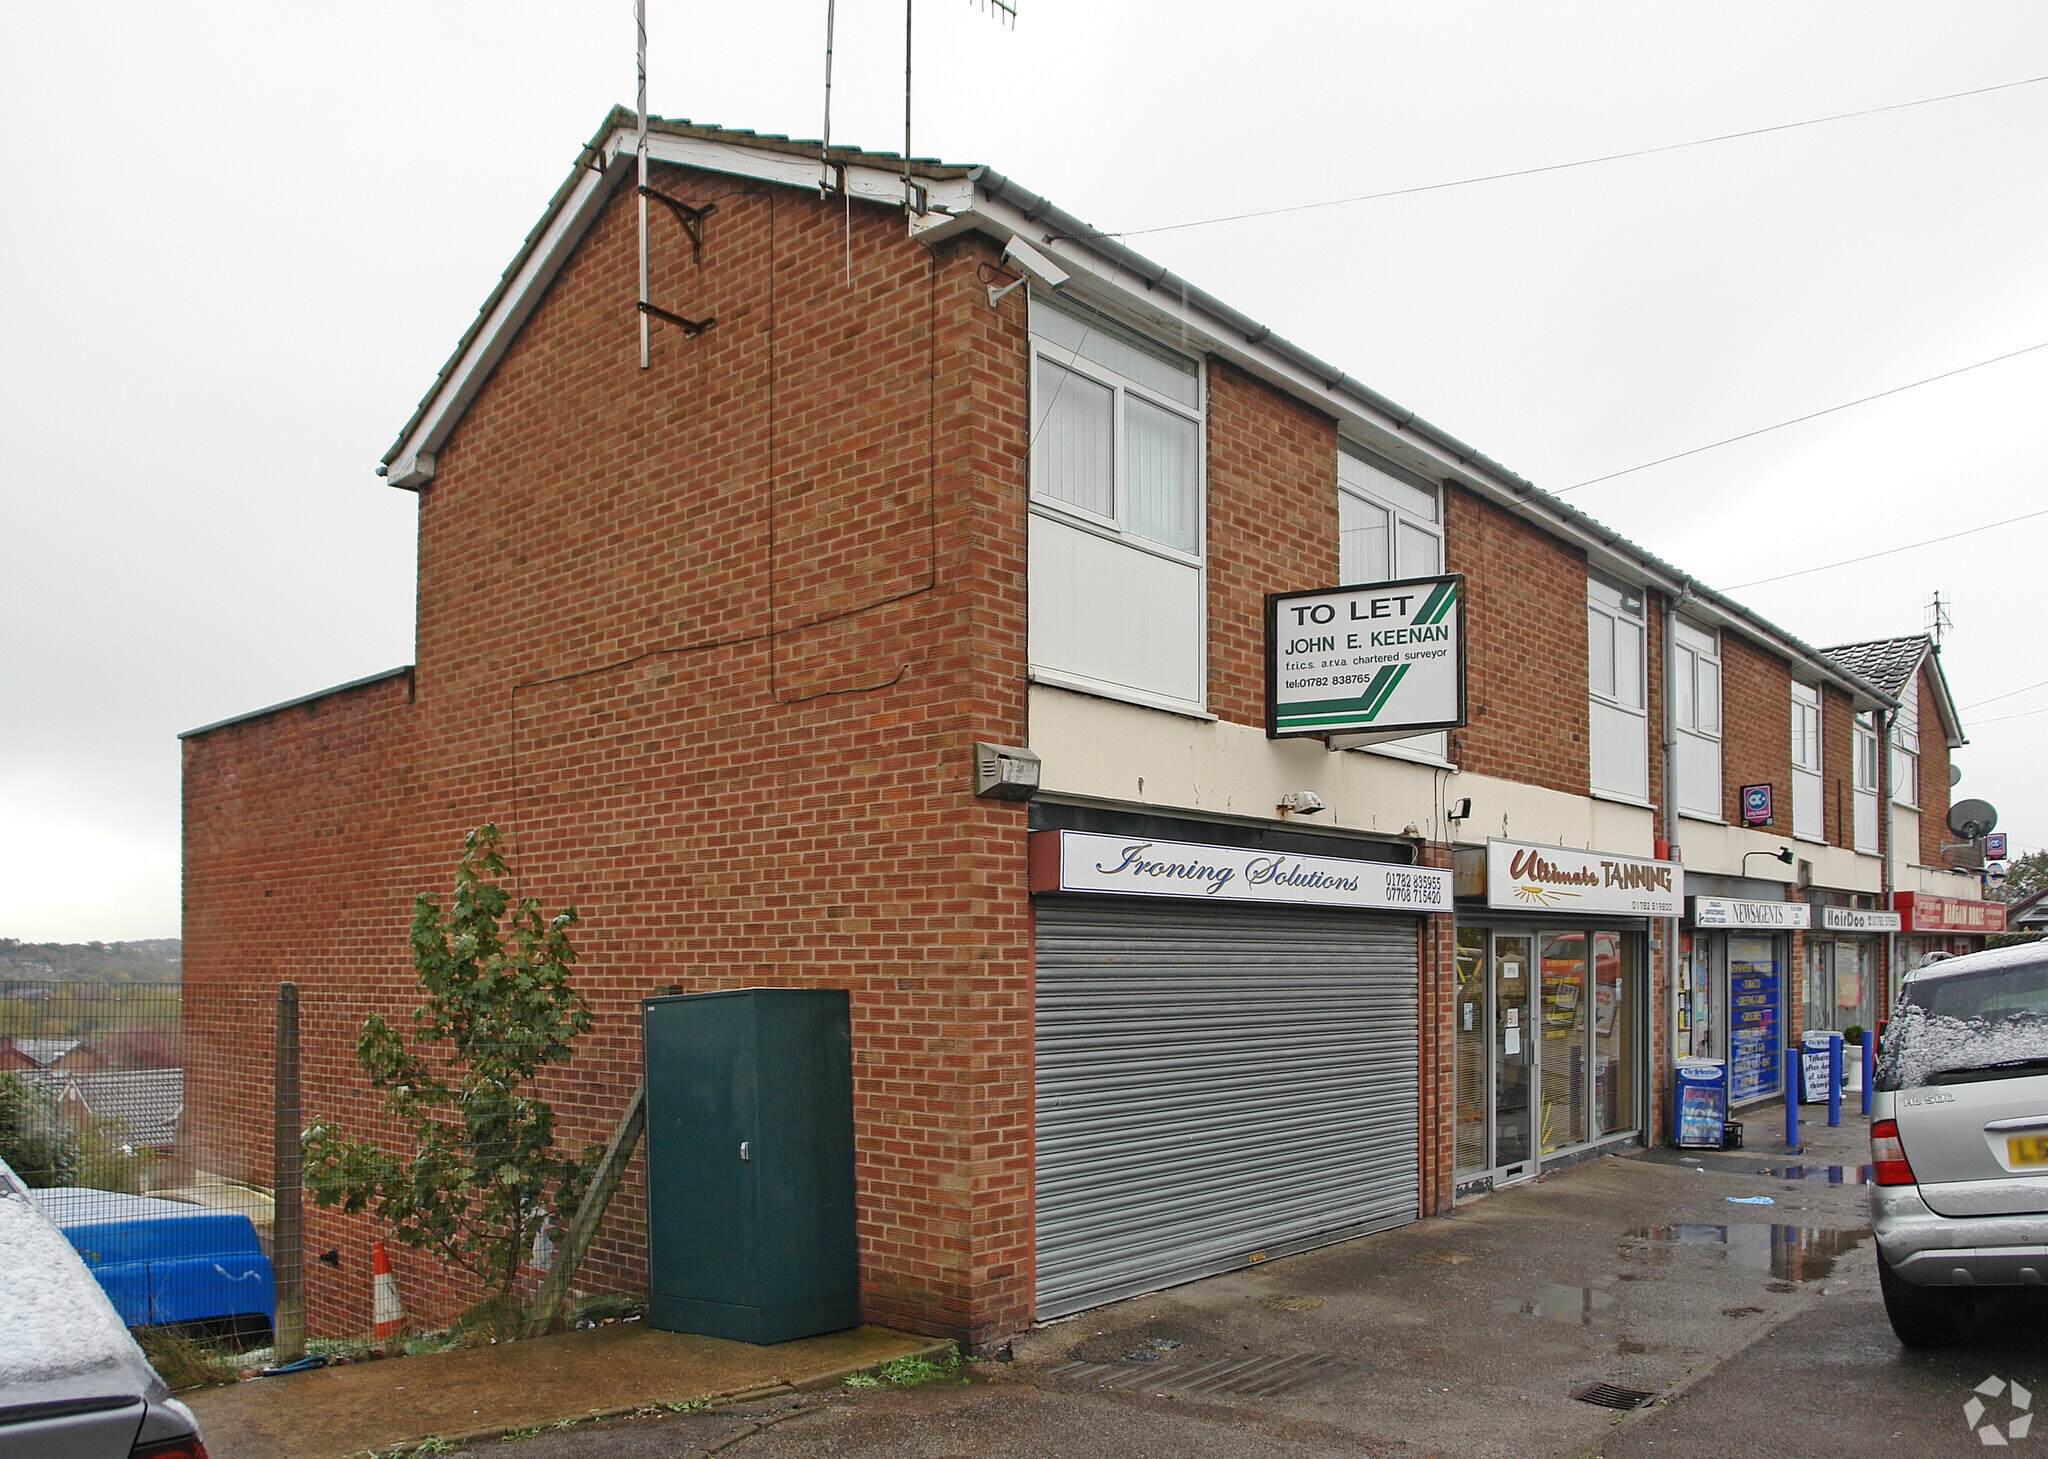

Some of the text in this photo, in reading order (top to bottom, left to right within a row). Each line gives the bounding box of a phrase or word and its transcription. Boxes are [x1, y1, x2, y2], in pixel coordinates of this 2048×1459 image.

[1290, 595, 1415, 626] TO LET
[1285, 625, 1449, 655] JOHN E. KEENAN
[1353, 651, 1400, 666] chartered
[1404, 648, 1448, 662] surveyor
[1332, 674, 1371, 686] 838765
[1096, 842, 1360, 894] Ironing Solutions
[1509, 848, 1672, 893] Ultimate TANNING
[1385, 872, 1442, 890] 01782 835955
[1385, 887, 1442, 904] 07708 715420
[1732, 903, 1784, 924] NEWSAGENTS
[1827, 909, 1865, 928] HairDoo
[1925, 1093, 1956, 1105] 500
